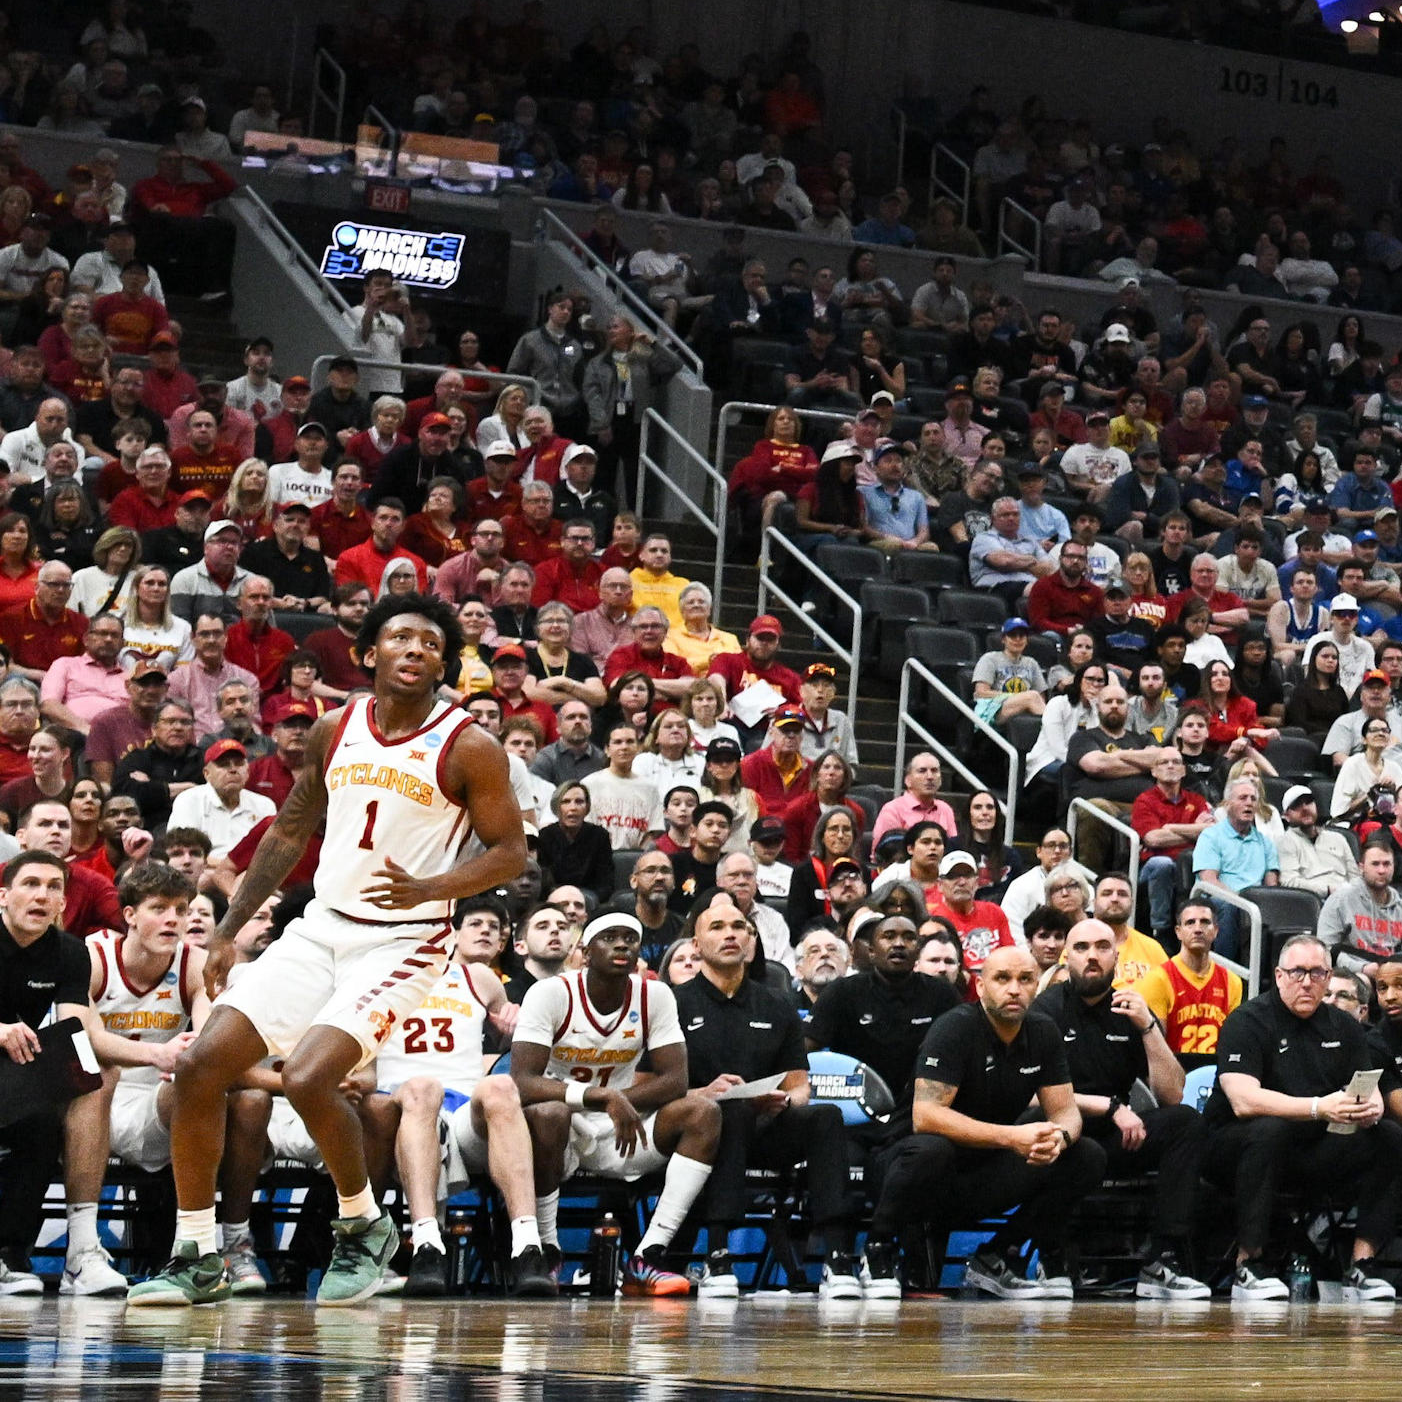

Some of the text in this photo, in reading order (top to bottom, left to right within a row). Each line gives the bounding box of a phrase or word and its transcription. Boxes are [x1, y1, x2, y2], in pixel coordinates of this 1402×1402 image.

[1221, 65, 1339, 109] 103 104
[371, 187, 407, 210] EXIT
[356, 229, 428, 256] MARCH
[362, 250, 459, 281] MADNESS
[329, 762, 434, 807] CYCLONES
[357, 800, 379, 851] 1
[402, 1017, 455, 1054] 23
[1180, 1024, 1218, 1055] 22
[811, 1075, 847, 1087] MARCH
[816, 1086, 864, 1098] MADNESS
